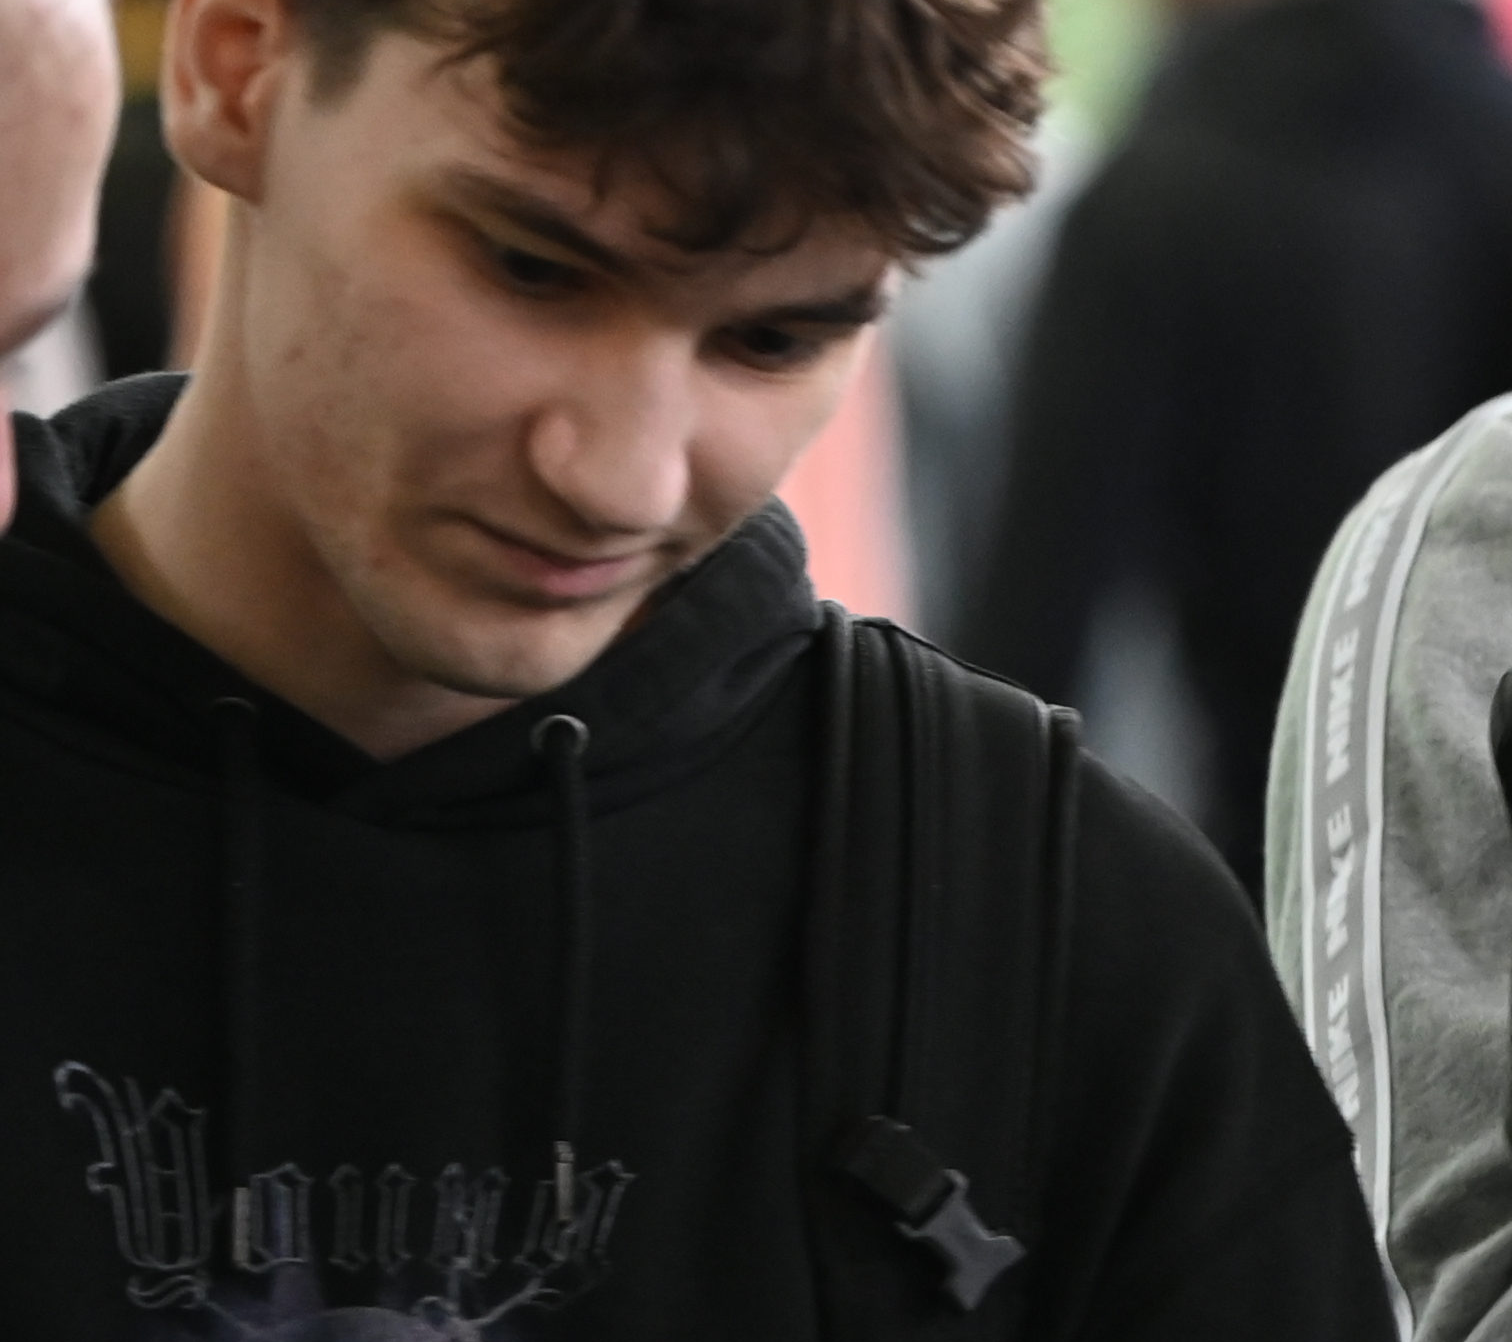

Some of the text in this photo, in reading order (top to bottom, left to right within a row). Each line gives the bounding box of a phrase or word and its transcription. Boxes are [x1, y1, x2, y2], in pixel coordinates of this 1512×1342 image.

[1325, 627, 1361, 786] NIKE
[1324, 802, 1357, 959] NIKE
[1327, 973, 1361, 1123] NIKE
